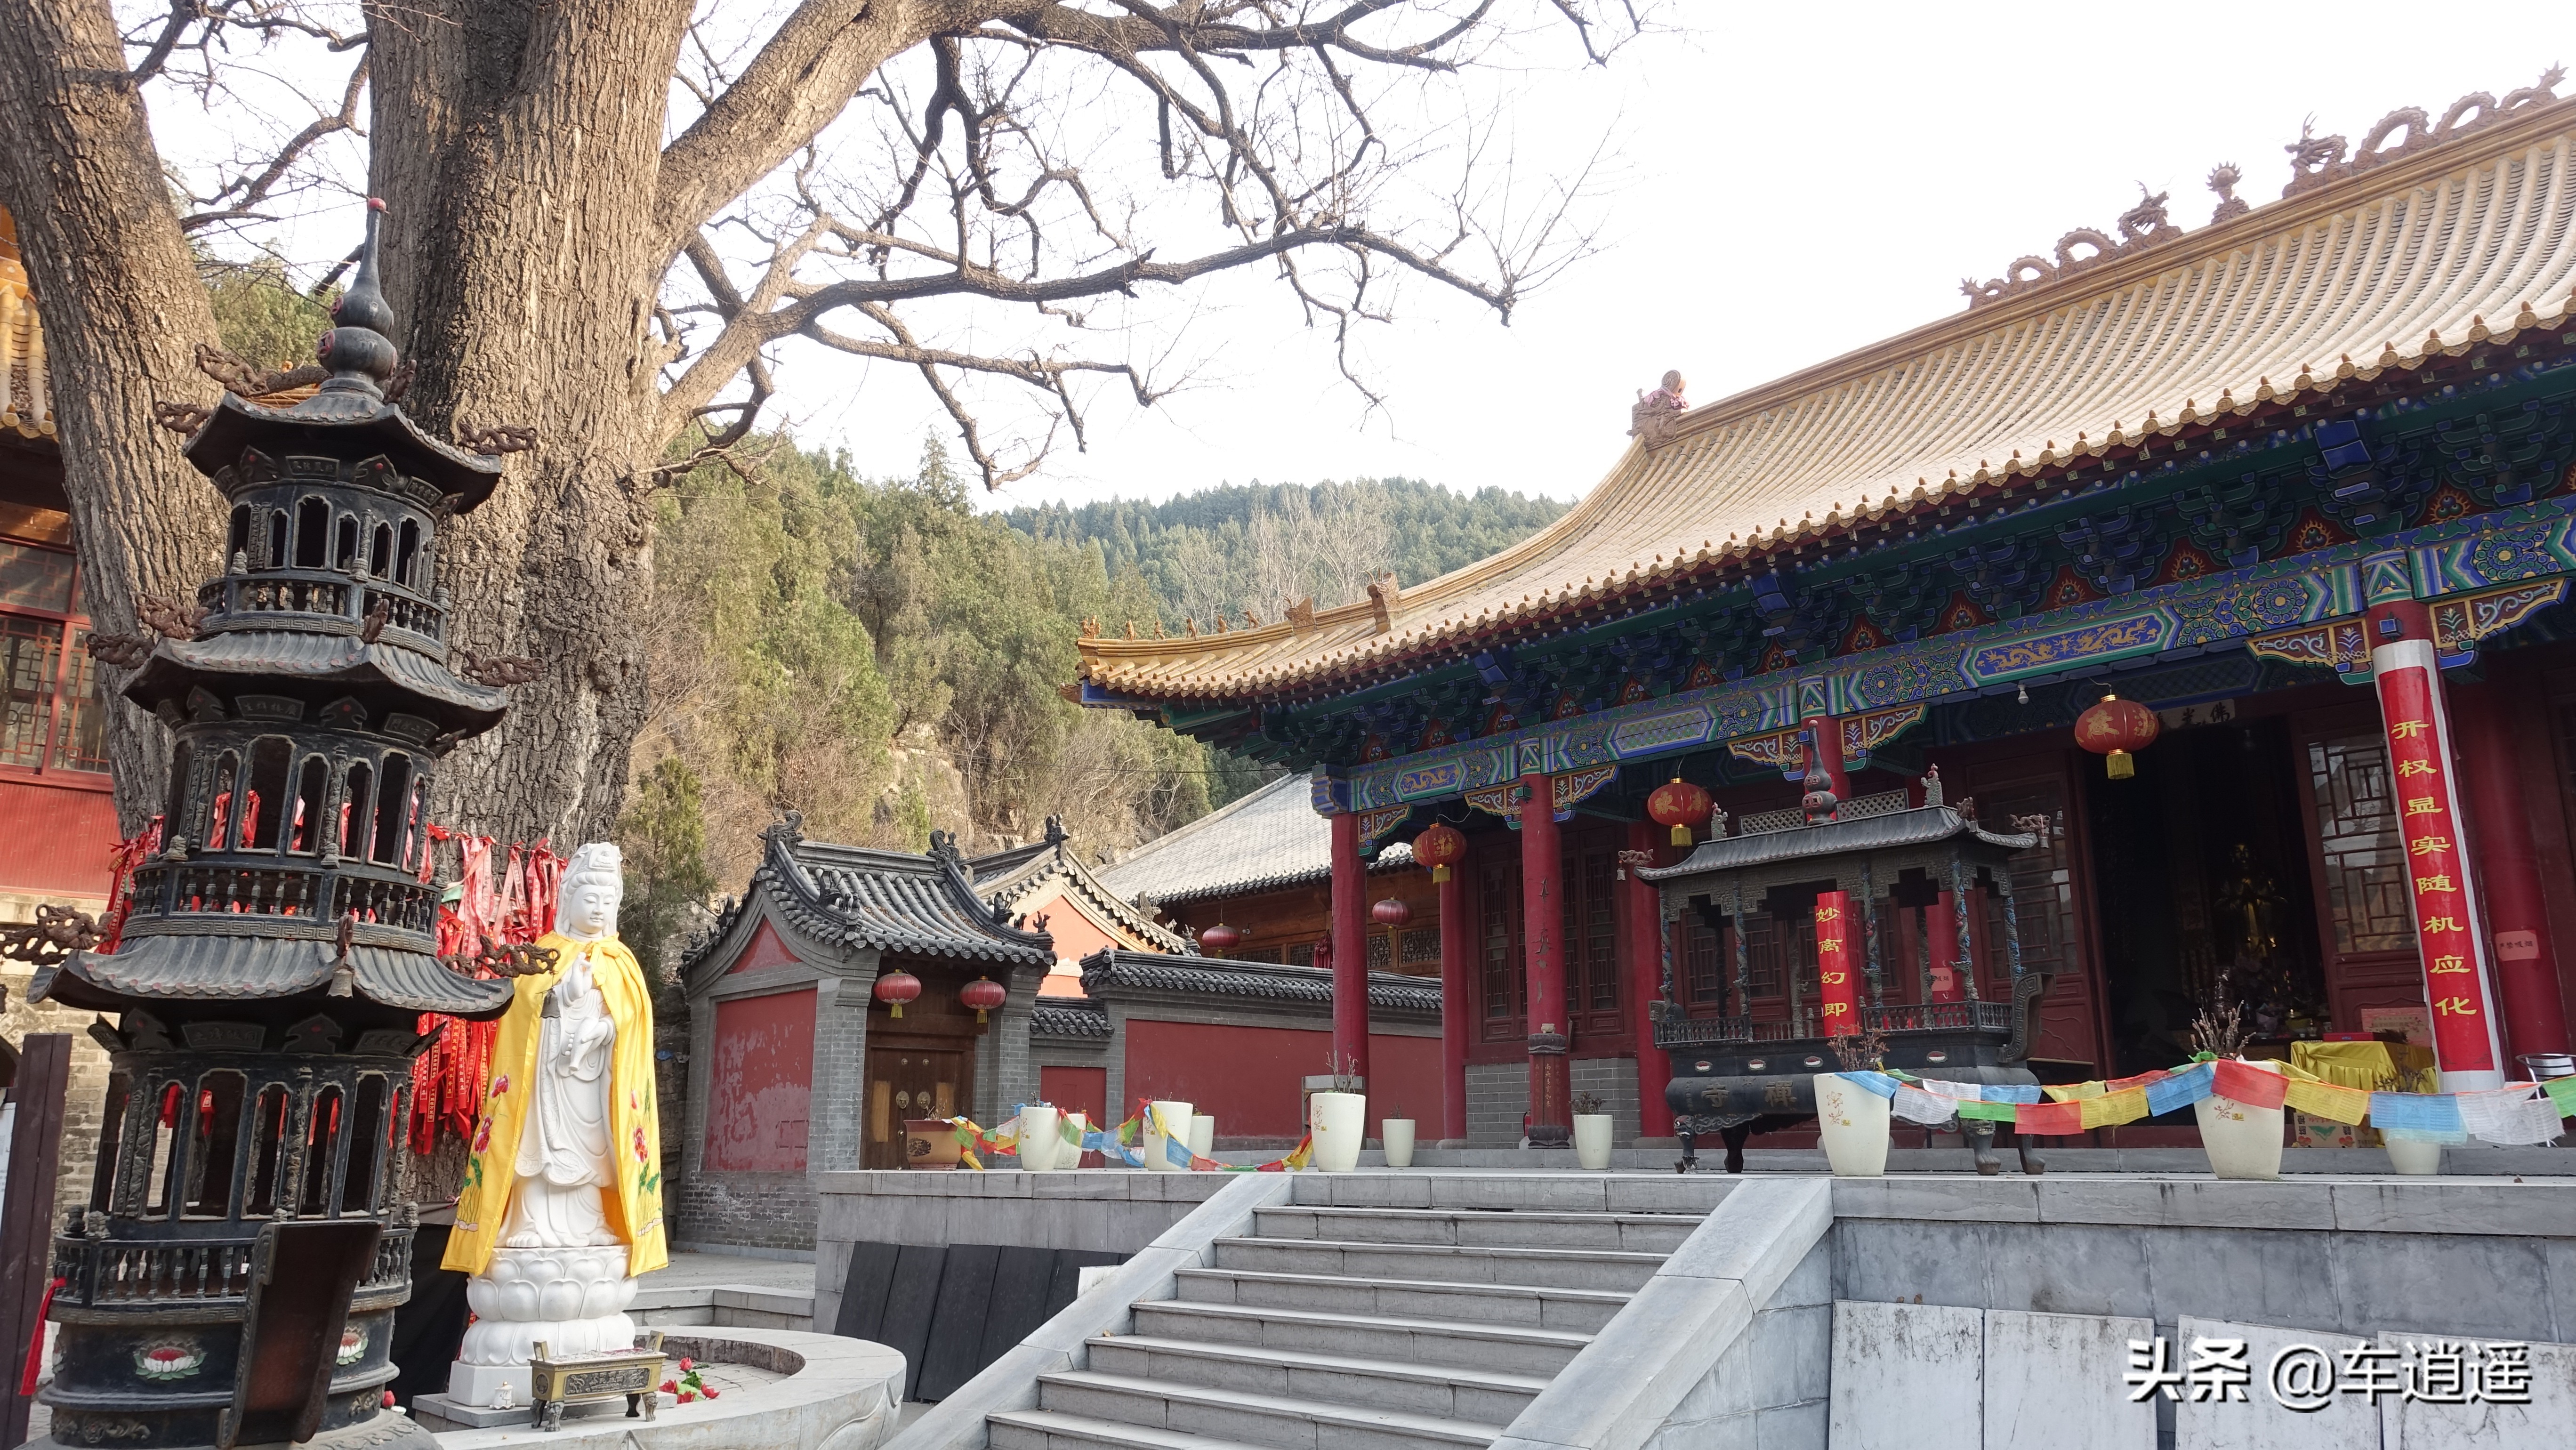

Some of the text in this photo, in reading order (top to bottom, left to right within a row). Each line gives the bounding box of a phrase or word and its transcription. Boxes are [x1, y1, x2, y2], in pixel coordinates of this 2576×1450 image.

[1815, 907, 1848, 1017] 妙离幻即
[2391, 719, 2478, 1017] 开权显实随机应化
